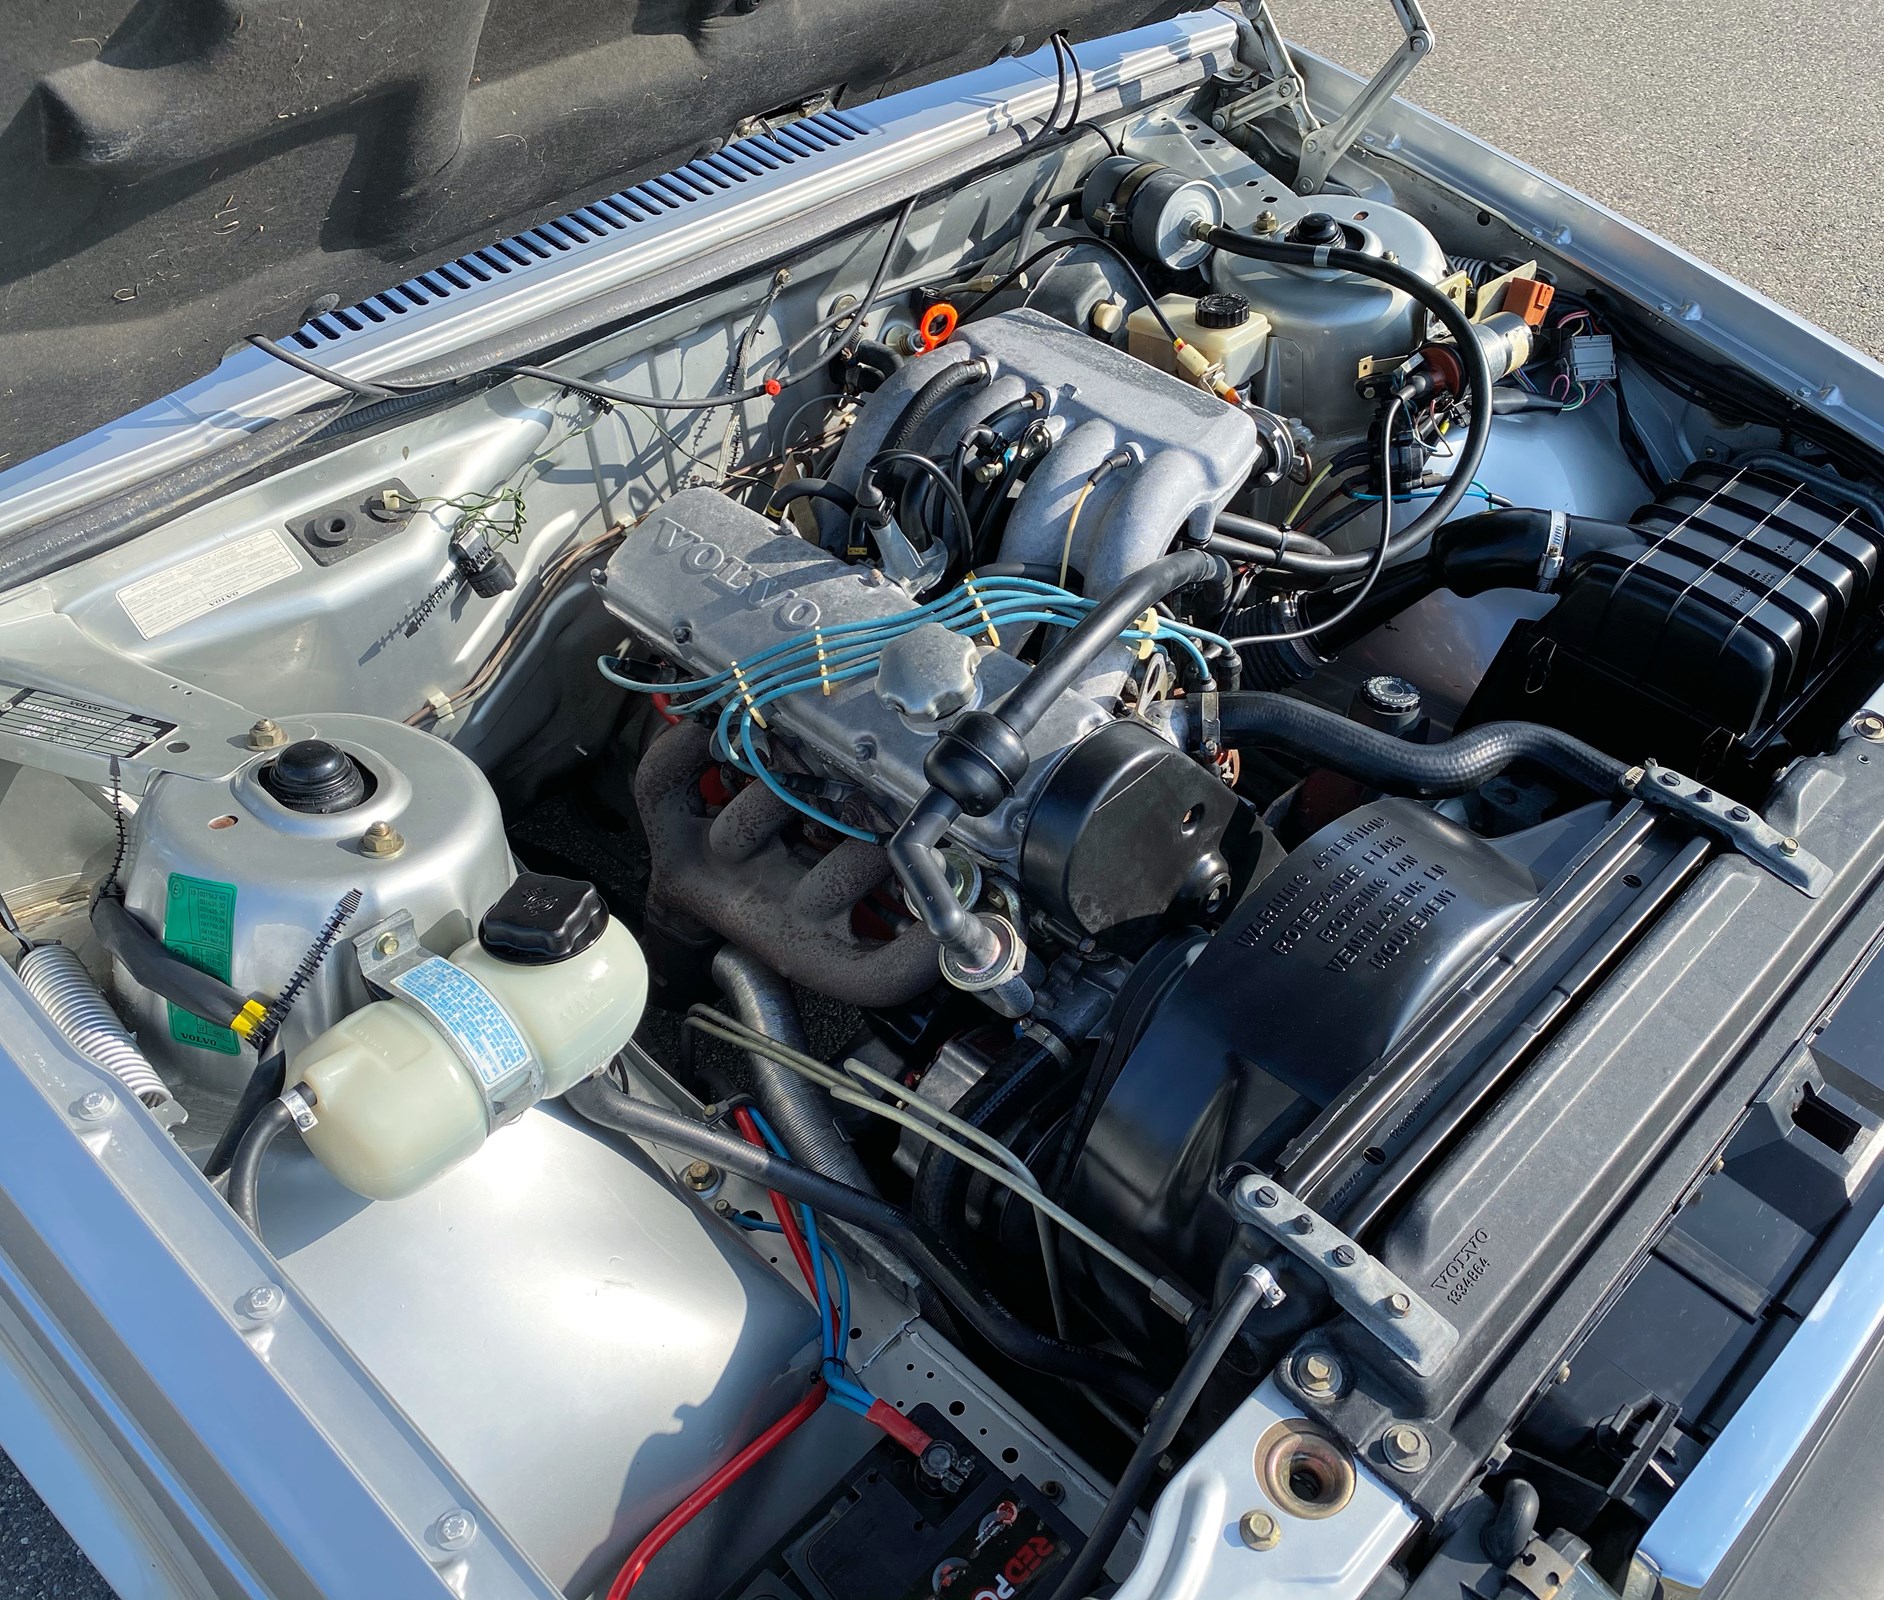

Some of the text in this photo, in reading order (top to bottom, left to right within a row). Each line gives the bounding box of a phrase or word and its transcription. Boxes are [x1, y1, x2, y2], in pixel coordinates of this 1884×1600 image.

[208, 591, 239, 607] VOLVO
[653, 516, 821, 630] VOLVO
[69, 700, 102, 711] VOLVO
[1236, 816, 1391, 947] WARNING ATTENTION!
[1272, 834, 1409, 955] ROTERANDE FLÄKT
[1317, 854, 1420, 944] ROTATING FAN
[1326, 863, 1450, 973] VENTILATEUR EN
[1368, 887, 1459, 970] MOUVEMENT
[437, 995, 457, 1015] VOLVO
[447, 983, 466, 1001] VOLVO
[180, 1032, 218, 1047] VOLVO
[1430, 1227, 1491, 1290] VOLVO
[1447, 1257, 1492, 1306] 1334864
[1004, 1535, 1055, 1585] RED
